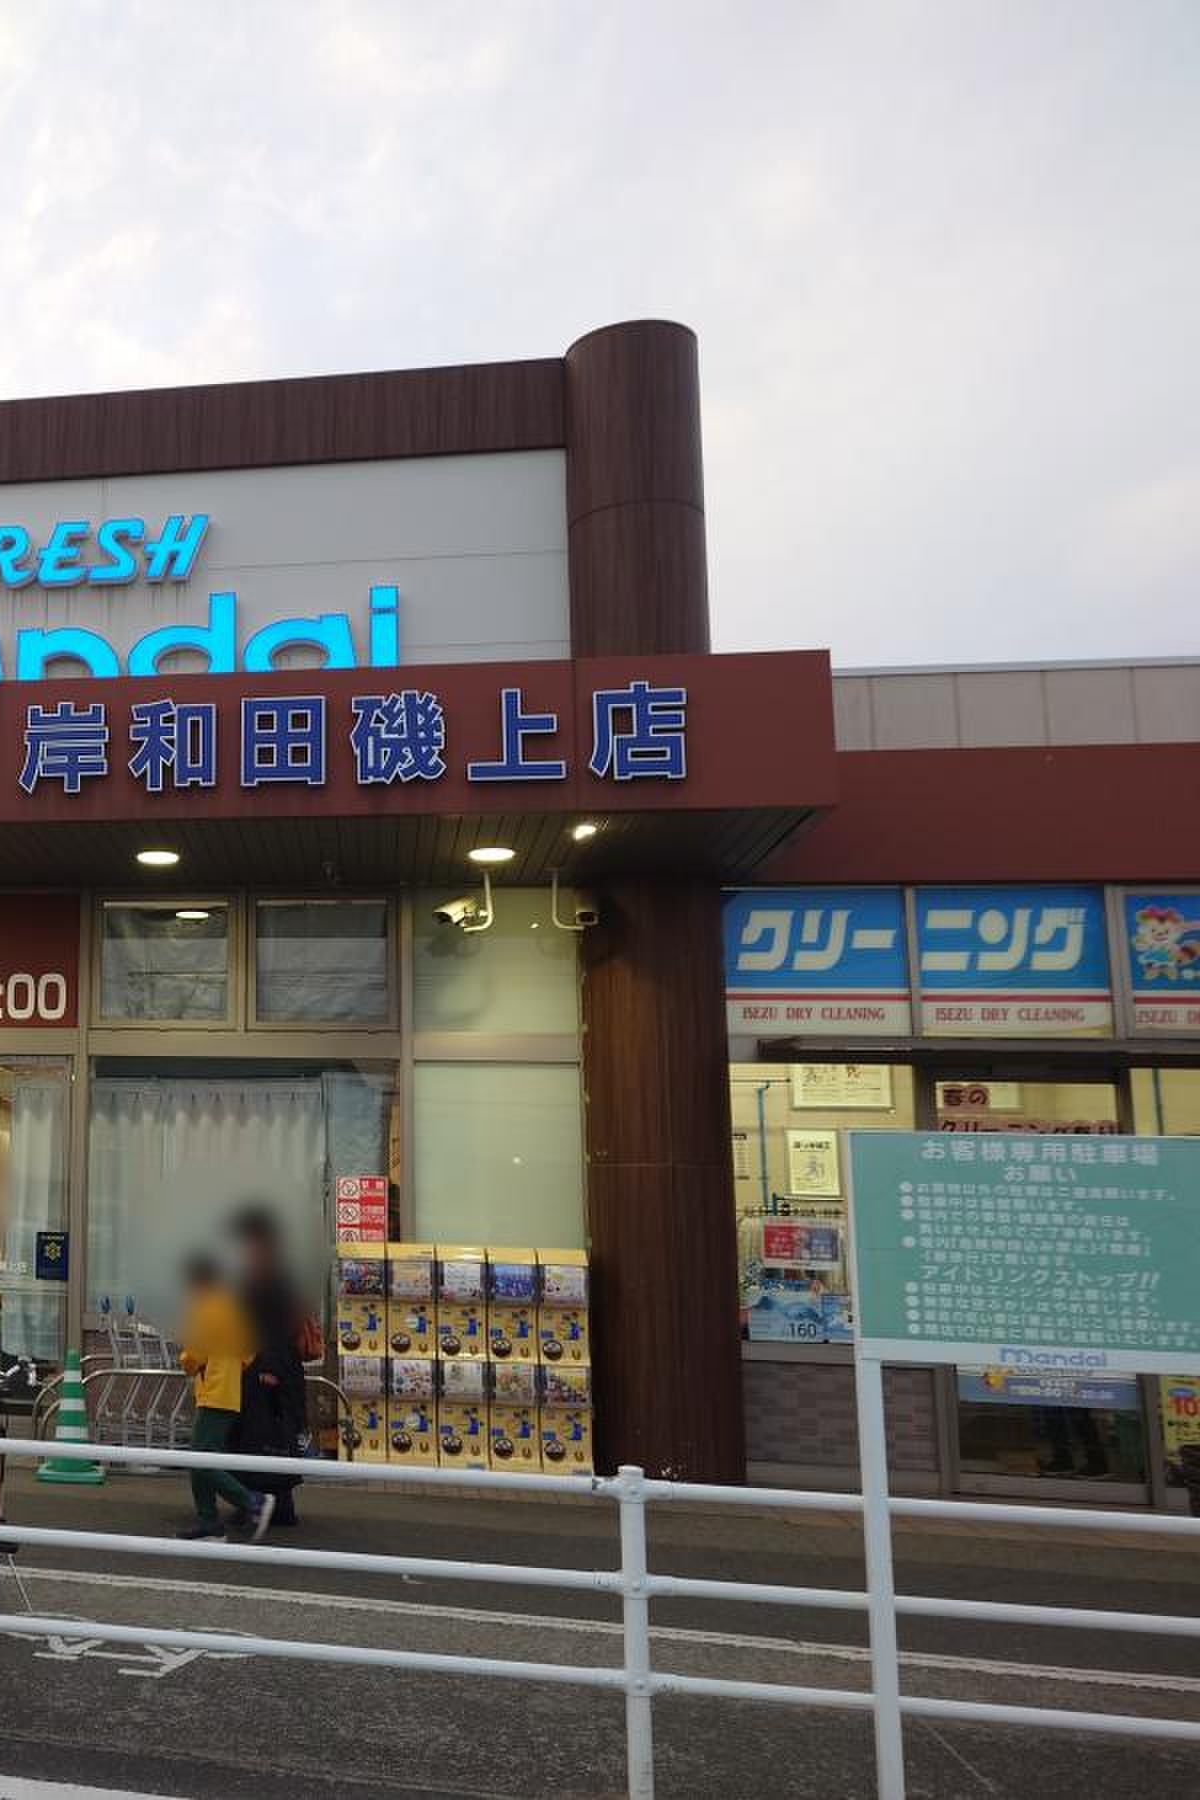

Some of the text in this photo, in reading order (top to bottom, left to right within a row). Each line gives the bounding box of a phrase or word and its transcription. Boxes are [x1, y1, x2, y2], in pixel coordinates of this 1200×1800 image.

[19, 682, 688, 794] 岸和田磯上店
[742, 1007, 885, 1020] ISEZU DRY CLEANING
[935, 1008, 1086, 1022] ISEZU DRY CLEANING
[1000, 1348, 1106, 1367] mandai
